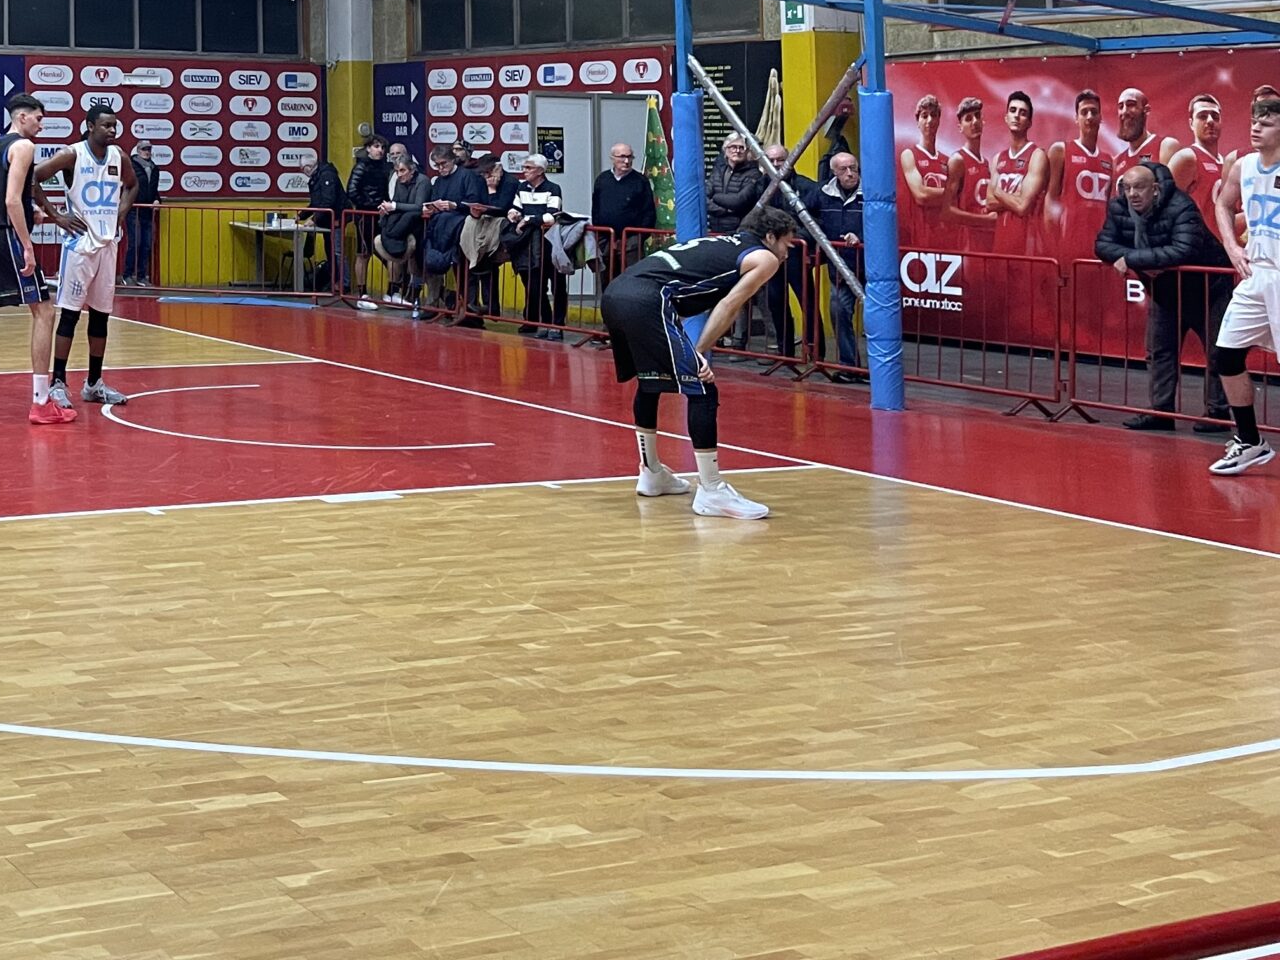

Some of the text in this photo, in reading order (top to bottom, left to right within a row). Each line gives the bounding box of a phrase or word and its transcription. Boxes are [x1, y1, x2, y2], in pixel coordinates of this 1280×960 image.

[238, 74, 262, 85] SIEV
[505, 69, 524, 82] SIEV
[385, 86, 405, 96] USCITA
[280, 102, 314, 112] DISARONNO
[382, 112, 408, 123] SERVIZIO
[395, 126, 408, 136] BAR
